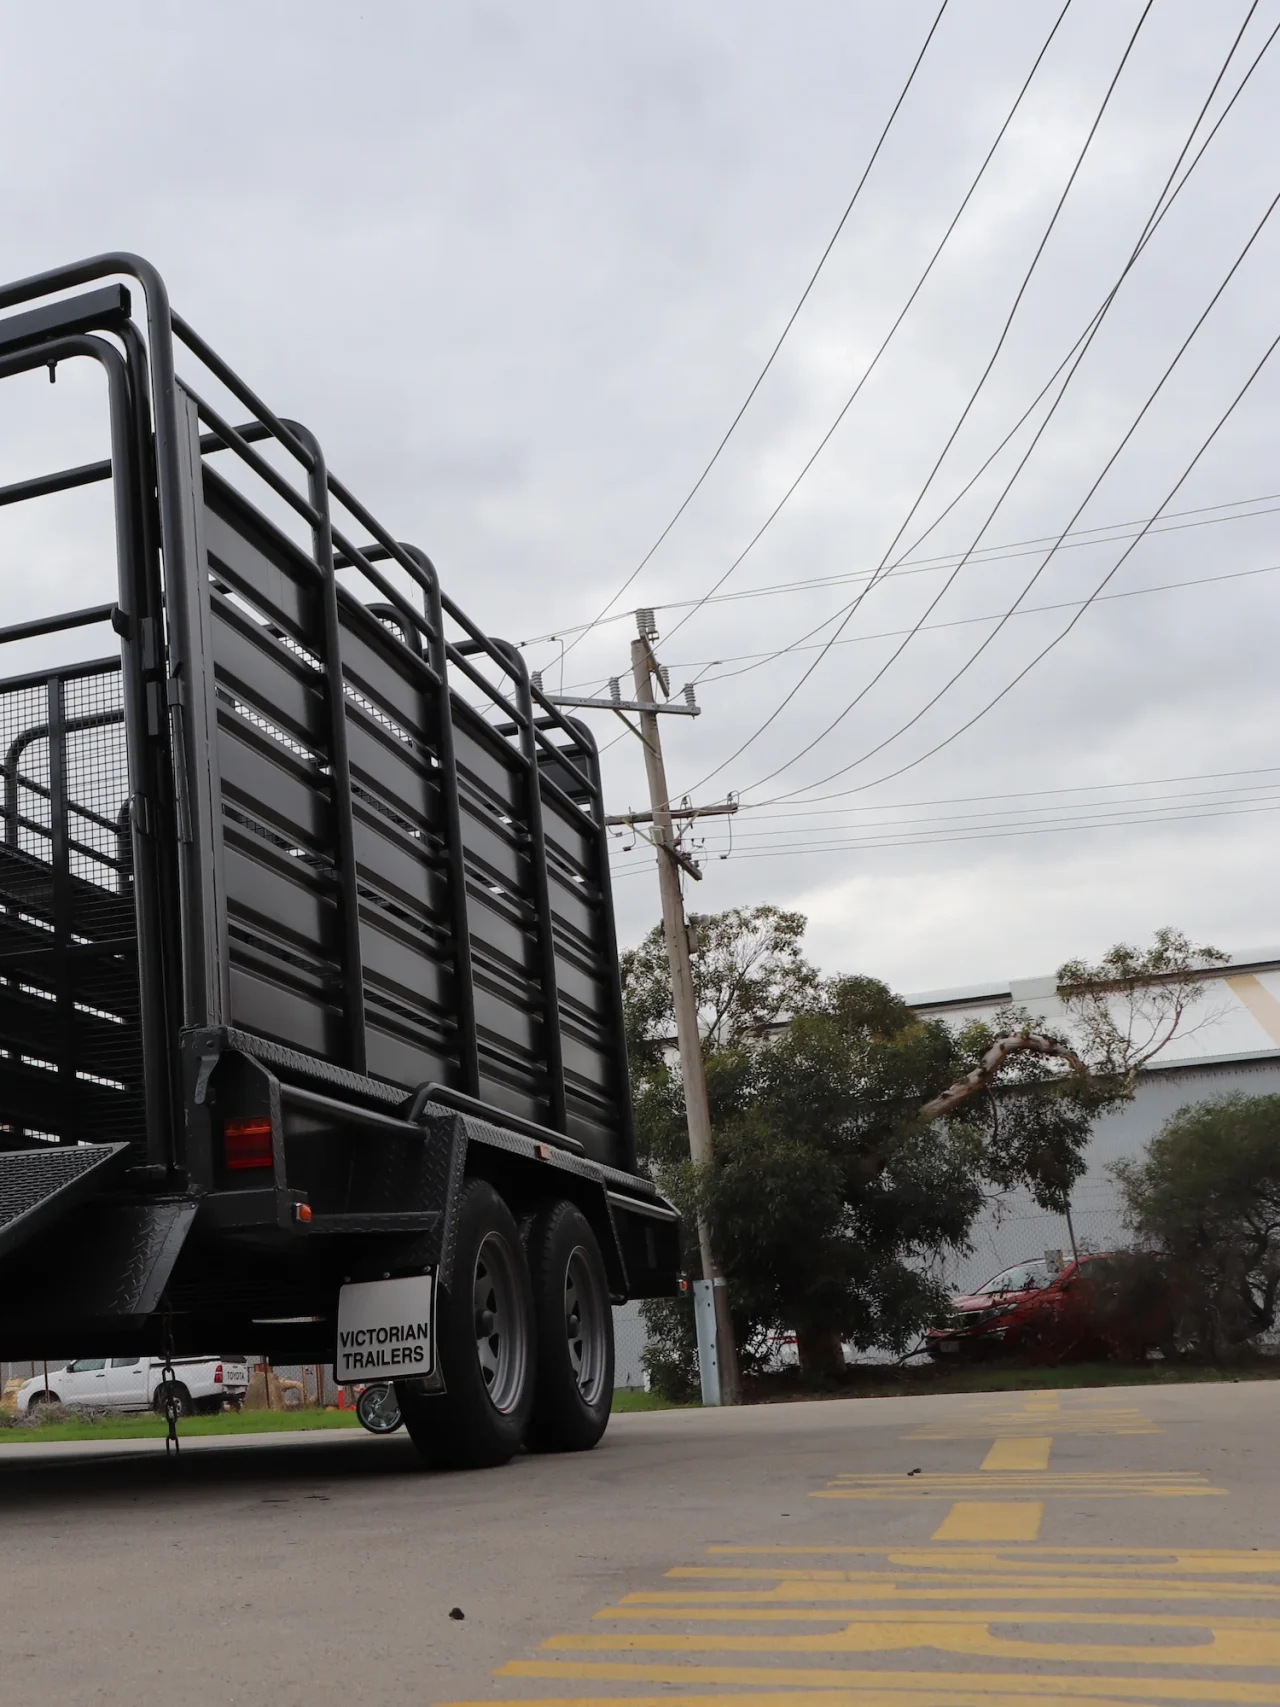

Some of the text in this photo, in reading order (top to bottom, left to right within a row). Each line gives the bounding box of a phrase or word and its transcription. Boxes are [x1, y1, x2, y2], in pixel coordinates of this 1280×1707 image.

[340, 1322, 428, 1348] VICTORIAN
[343, 1345, 424, 1370] TRAILERS
[227, 1371, 245, 1380] TOYOTA
